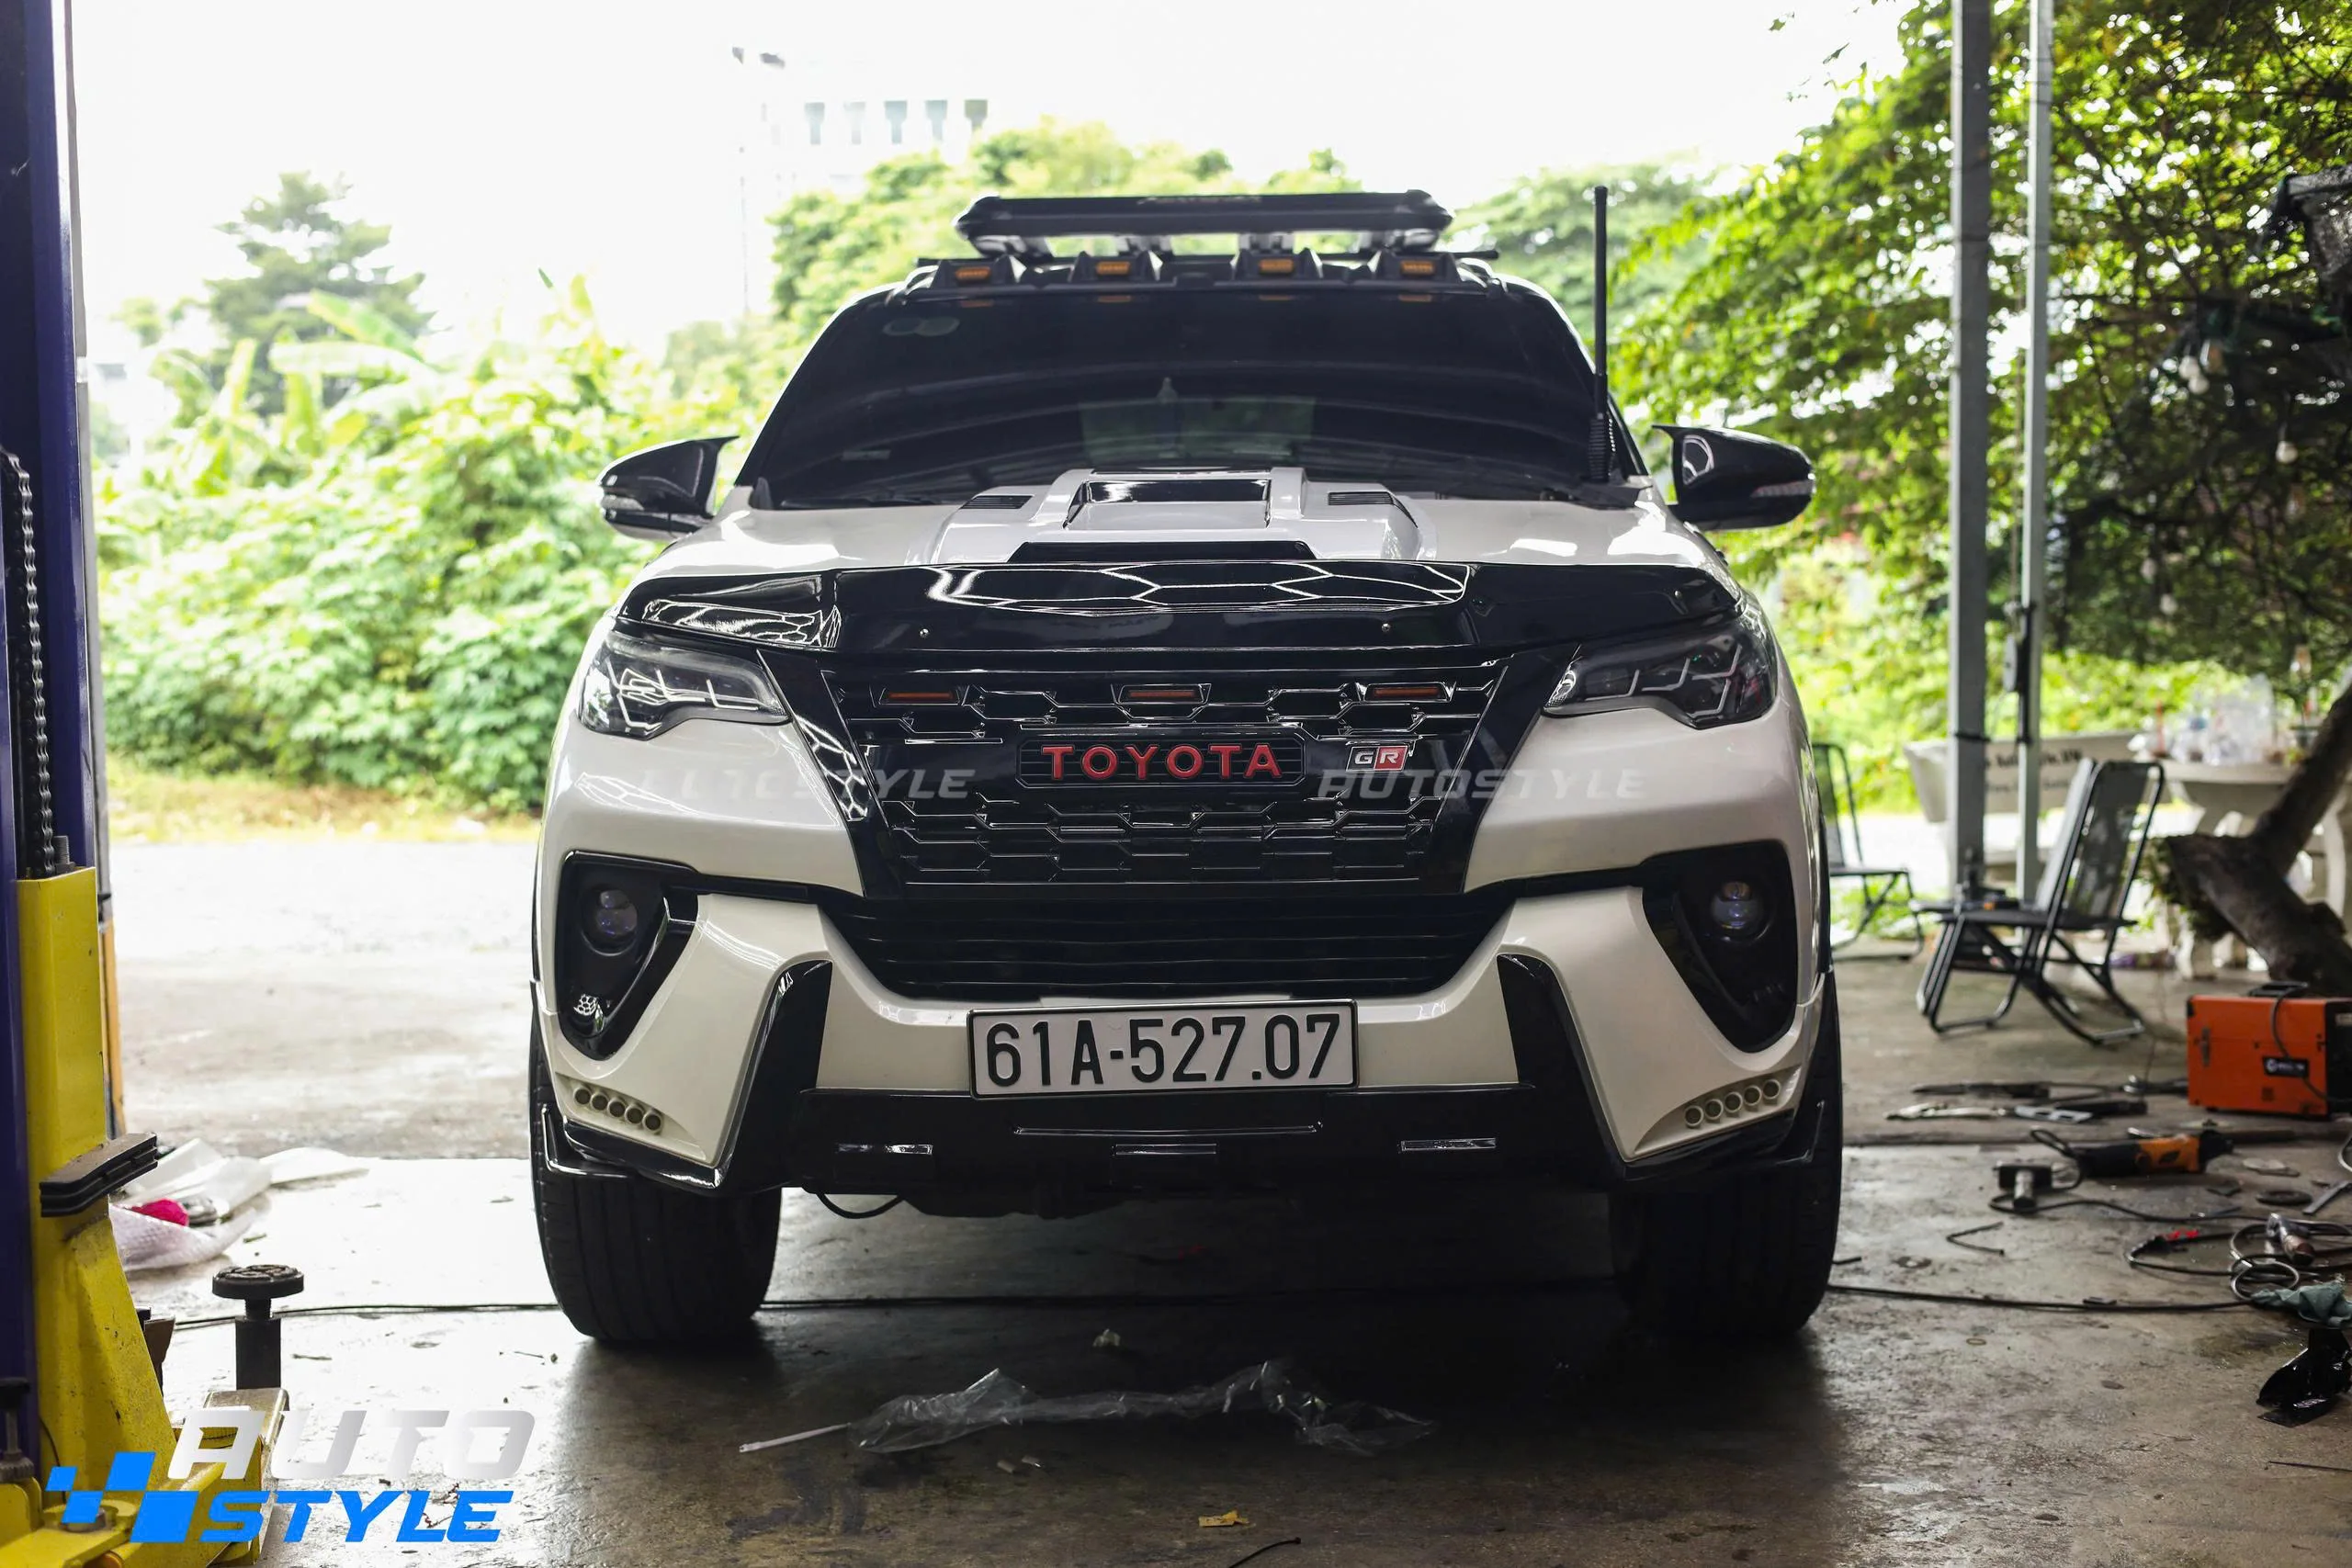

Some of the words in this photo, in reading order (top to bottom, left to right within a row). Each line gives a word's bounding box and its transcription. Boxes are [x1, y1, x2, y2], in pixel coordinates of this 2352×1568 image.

[1041, 744, 1283, 780] TOYOTA
[1353, 749, 1401, 765] GR
[986, 1012, 1340, 1087] 61A-527.07
